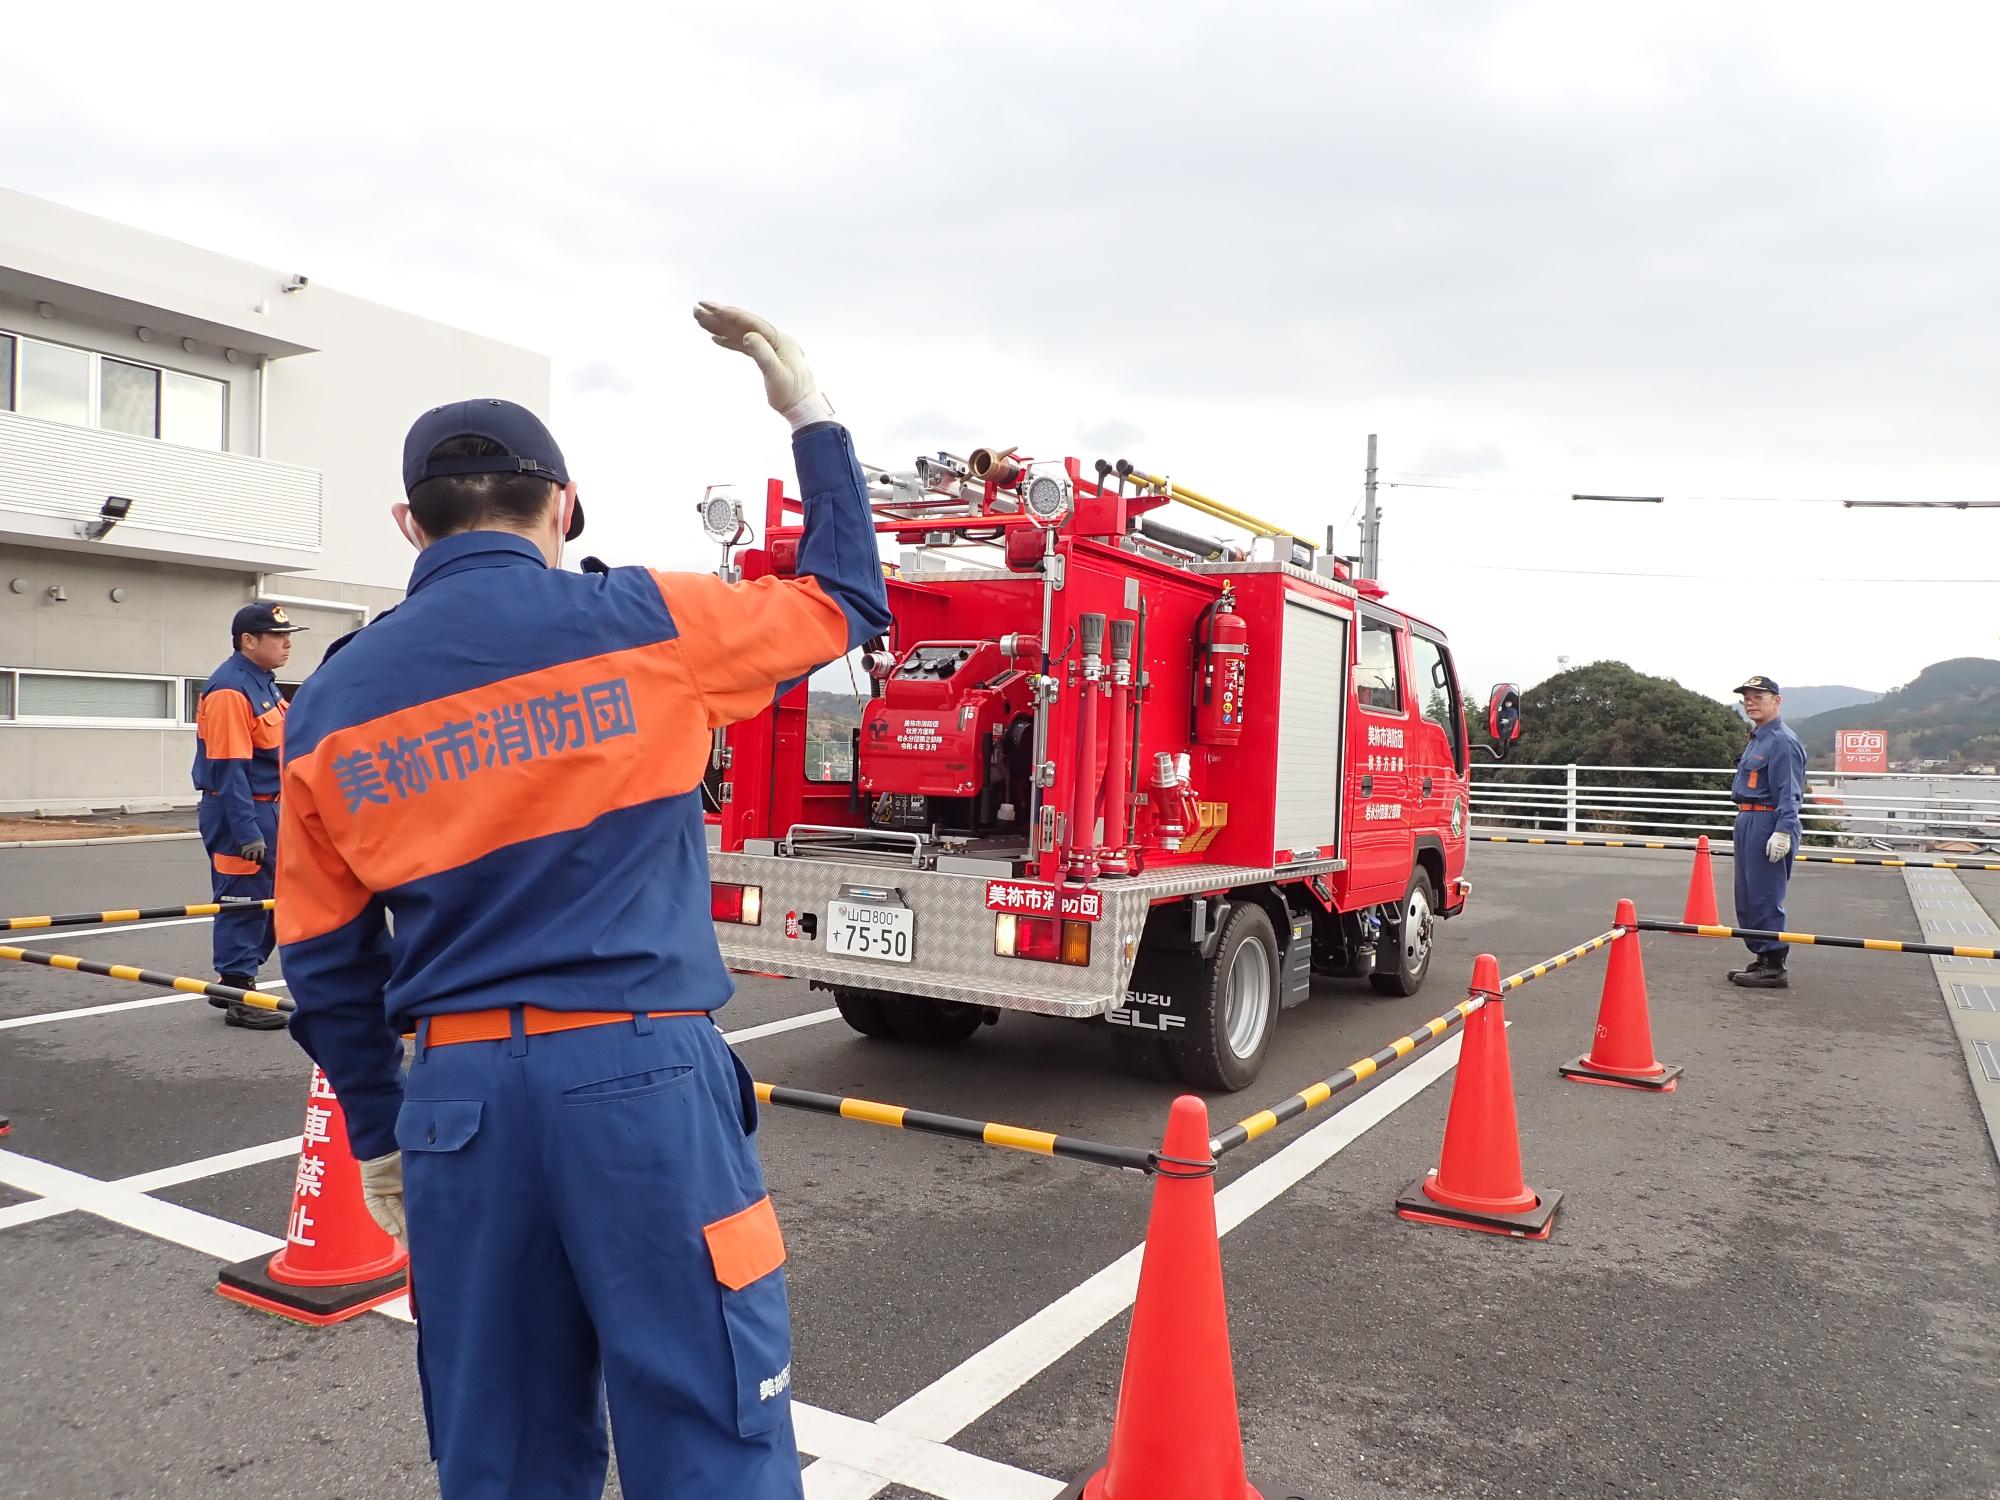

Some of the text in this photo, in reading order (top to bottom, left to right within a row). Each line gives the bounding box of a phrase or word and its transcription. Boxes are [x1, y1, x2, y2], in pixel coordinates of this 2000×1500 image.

[329, 678, 637, 815] 美祢市消防団
[846, 925, 907, 957] 75-50
[1125, 991, 1171, 1007] SUZU
[1105, 1008, 1186, 1031] ELF
